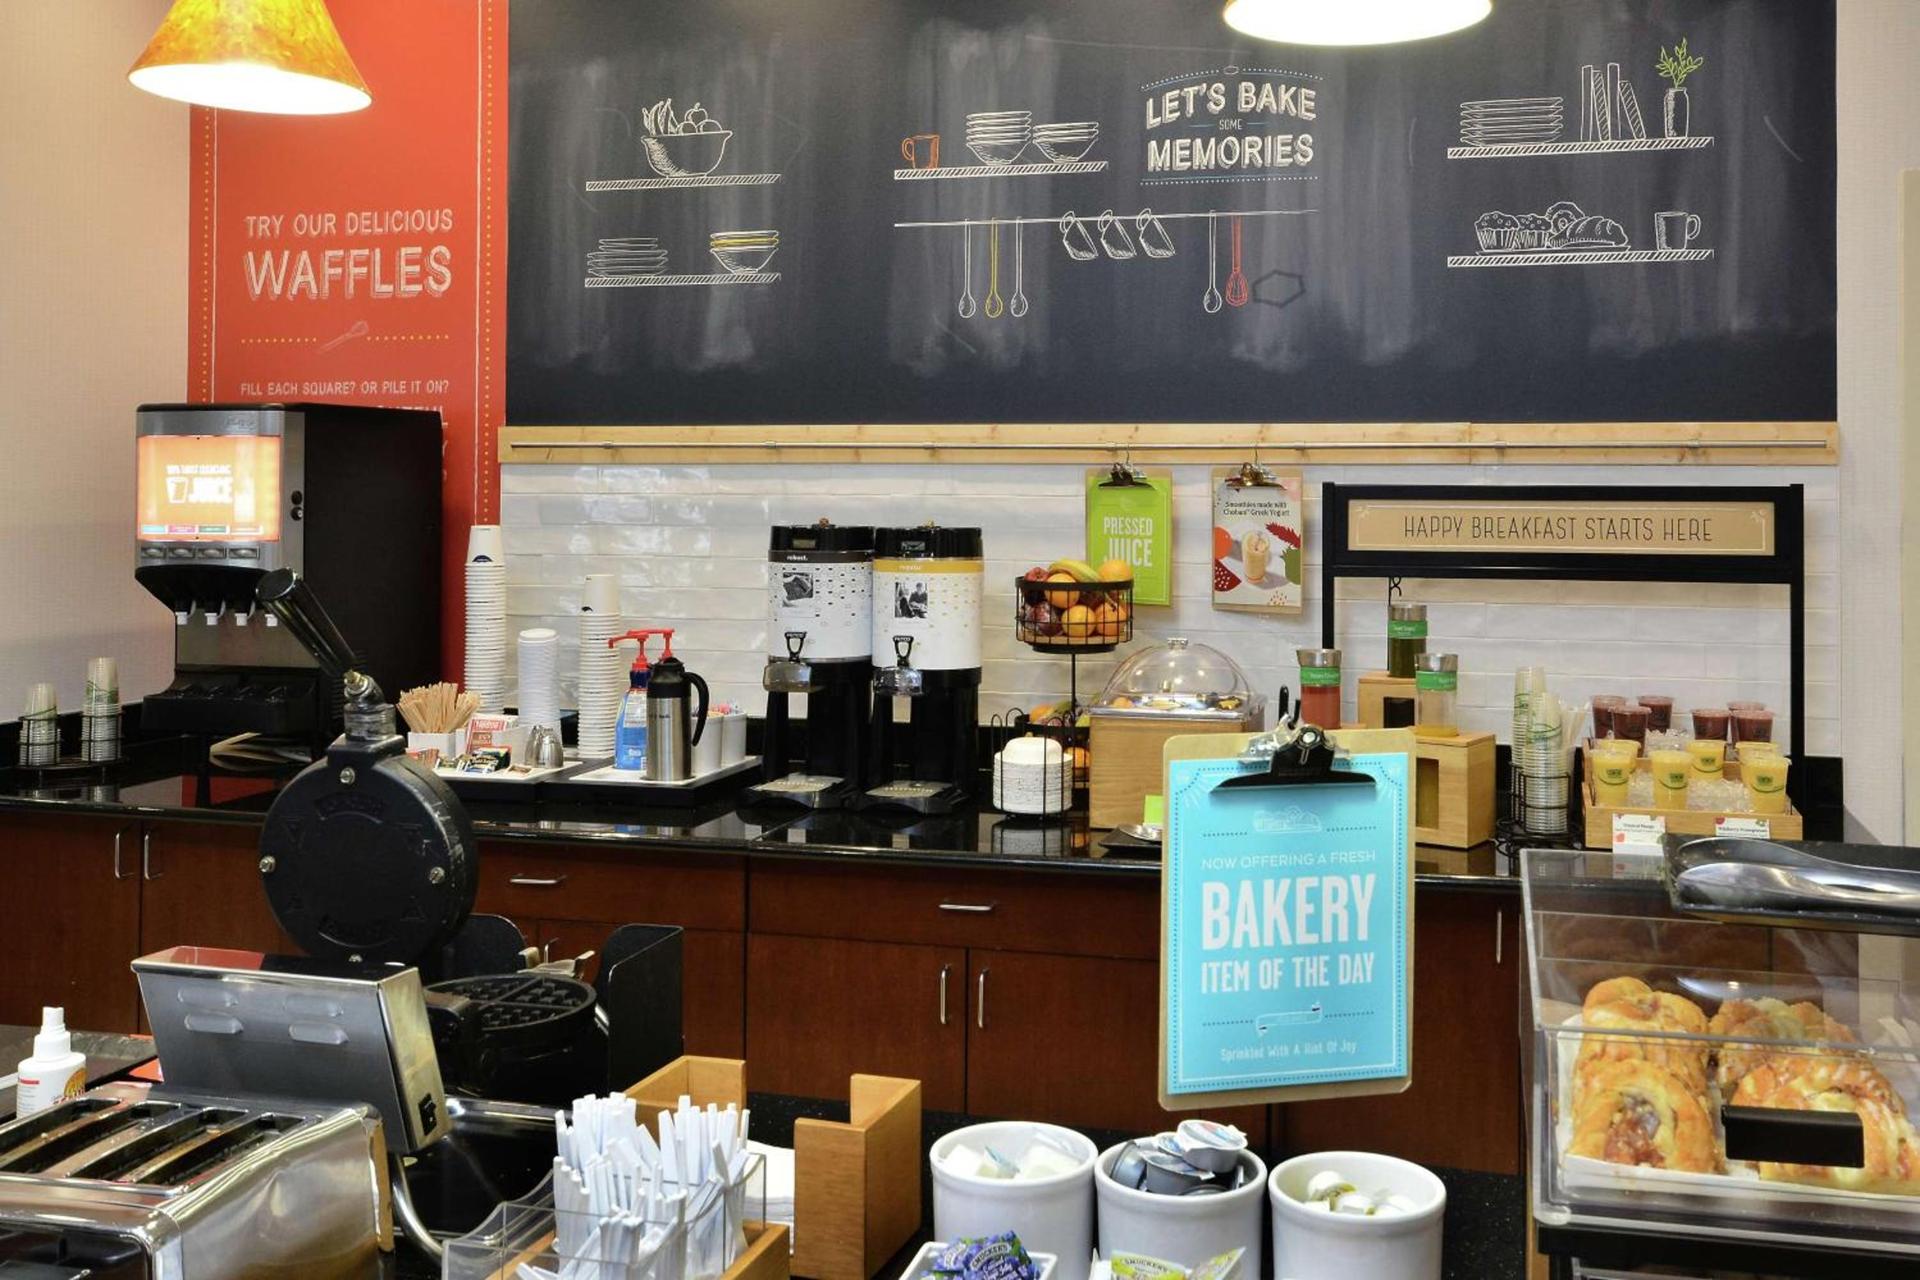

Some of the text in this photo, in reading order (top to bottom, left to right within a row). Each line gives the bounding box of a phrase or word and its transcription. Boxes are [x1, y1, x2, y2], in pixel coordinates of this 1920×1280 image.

[1146, 81, 1316, 129] LET'S BAKE
[1219, 119, 1243, 130] SOME
[1147, 133, 1314, 172] MEMORIES
[245, 208, 453, 239] TRY OUR DELICIOUS
[243, 245, 452, 300] WAFFLES
[241, 379, 449, 396] FILL EACH SQUARE? OR PILE IT ON?
[1103, 516, 1153, 536] PRESSED
[1404, 515, 1713, 542] HAPPY BREAKFAST STARTS HERE
[1103, 538, 1153, 567] JUICE
[1202, 850, 1376, 870] NOW OFFERING A FRESH
[1202, 873, 1376, 950] BAKERY
[1201, 952, 1374, 994] ITEM OF THE DAY
[1221, 1046, 1263, 1063] Sprinkled
[1267, 1045, 1289, 1057] With
[1294, 1044, 1300, 1054] A
[1327, 1041, 1337, 1054] Of
[1341, 1040, 1357, 1055] Joy
